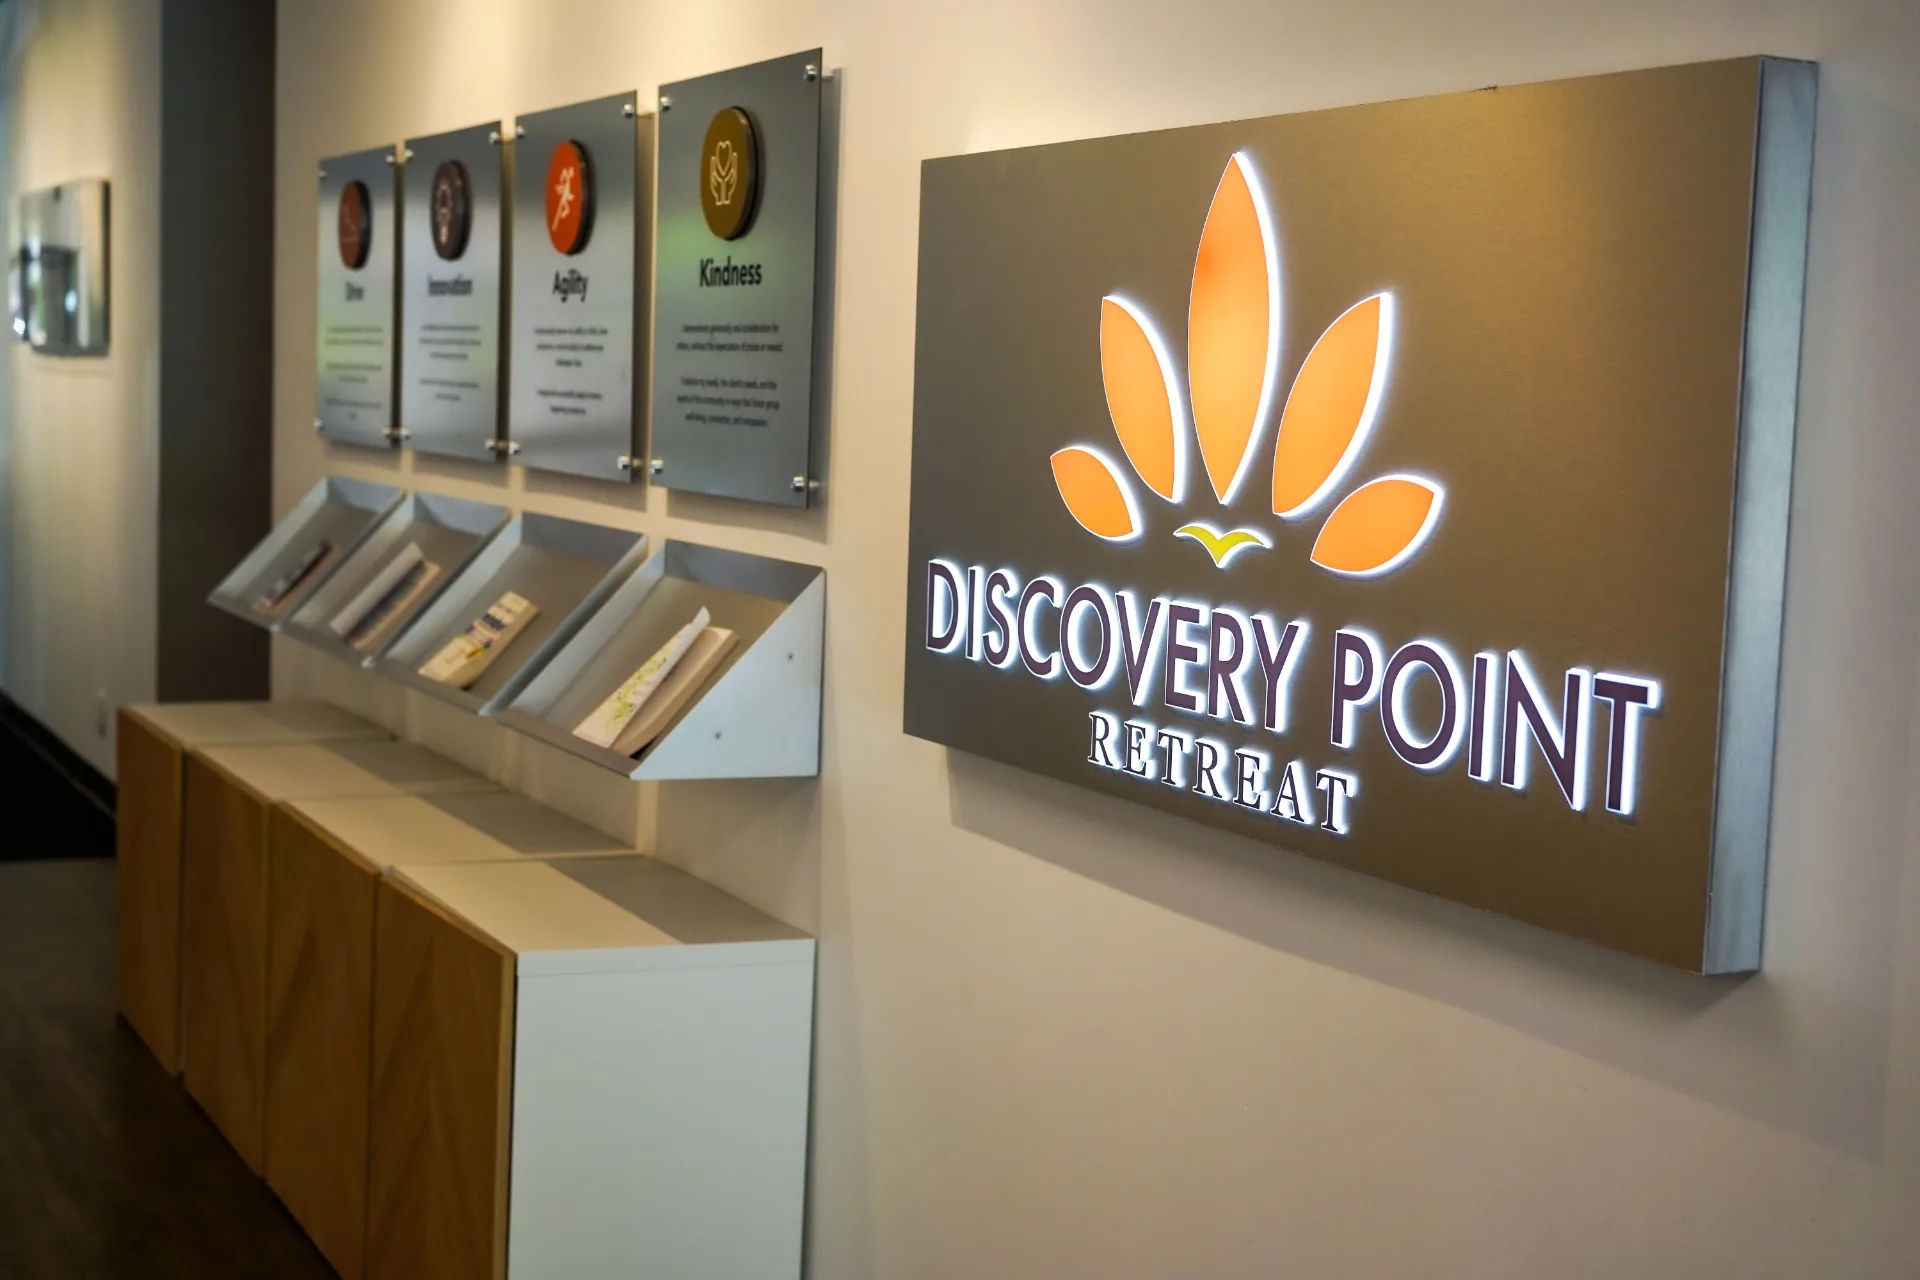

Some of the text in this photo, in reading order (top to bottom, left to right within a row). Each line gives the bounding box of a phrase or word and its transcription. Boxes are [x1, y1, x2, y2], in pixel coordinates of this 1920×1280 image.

[553, 269, 588, 303] Agility
[700, 256, 762, 287] Kindness
[926, 559, 1659, 816] DISCOVERY POINT
[1088, 711, 1357, 834] RETREAT
